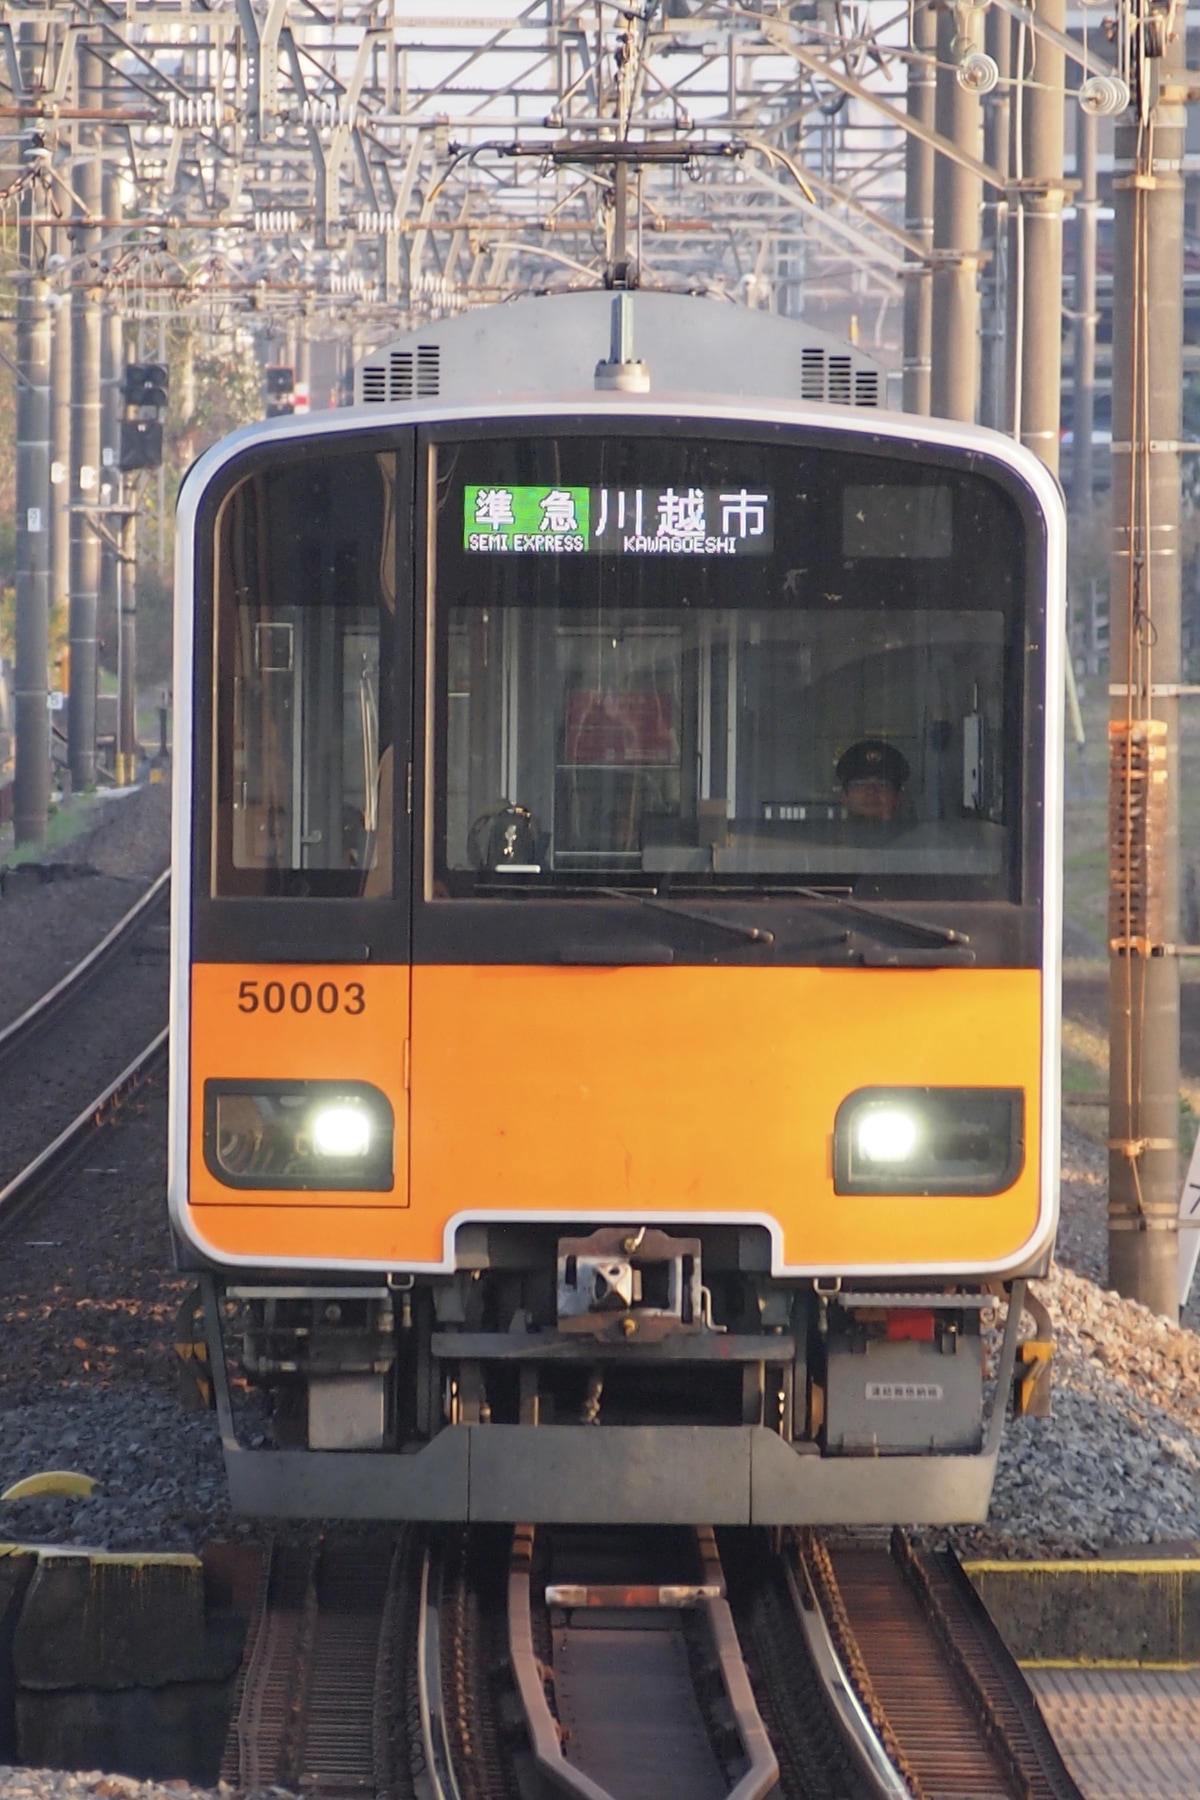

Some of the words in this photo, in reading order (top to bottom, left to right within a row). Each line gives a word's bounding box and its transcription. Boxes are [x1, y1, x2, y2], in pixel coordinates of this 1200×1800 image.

[475, 489, 578, 531] 準急
[595, 488, 768, 537] 川越市
[468, 533, 509, 552] SEMI
[513, 533, 584, 552] EXPRESS
[623, 536, 737, 554] KAWAGOESHI
[238, 981, 366, 1015] 50003
